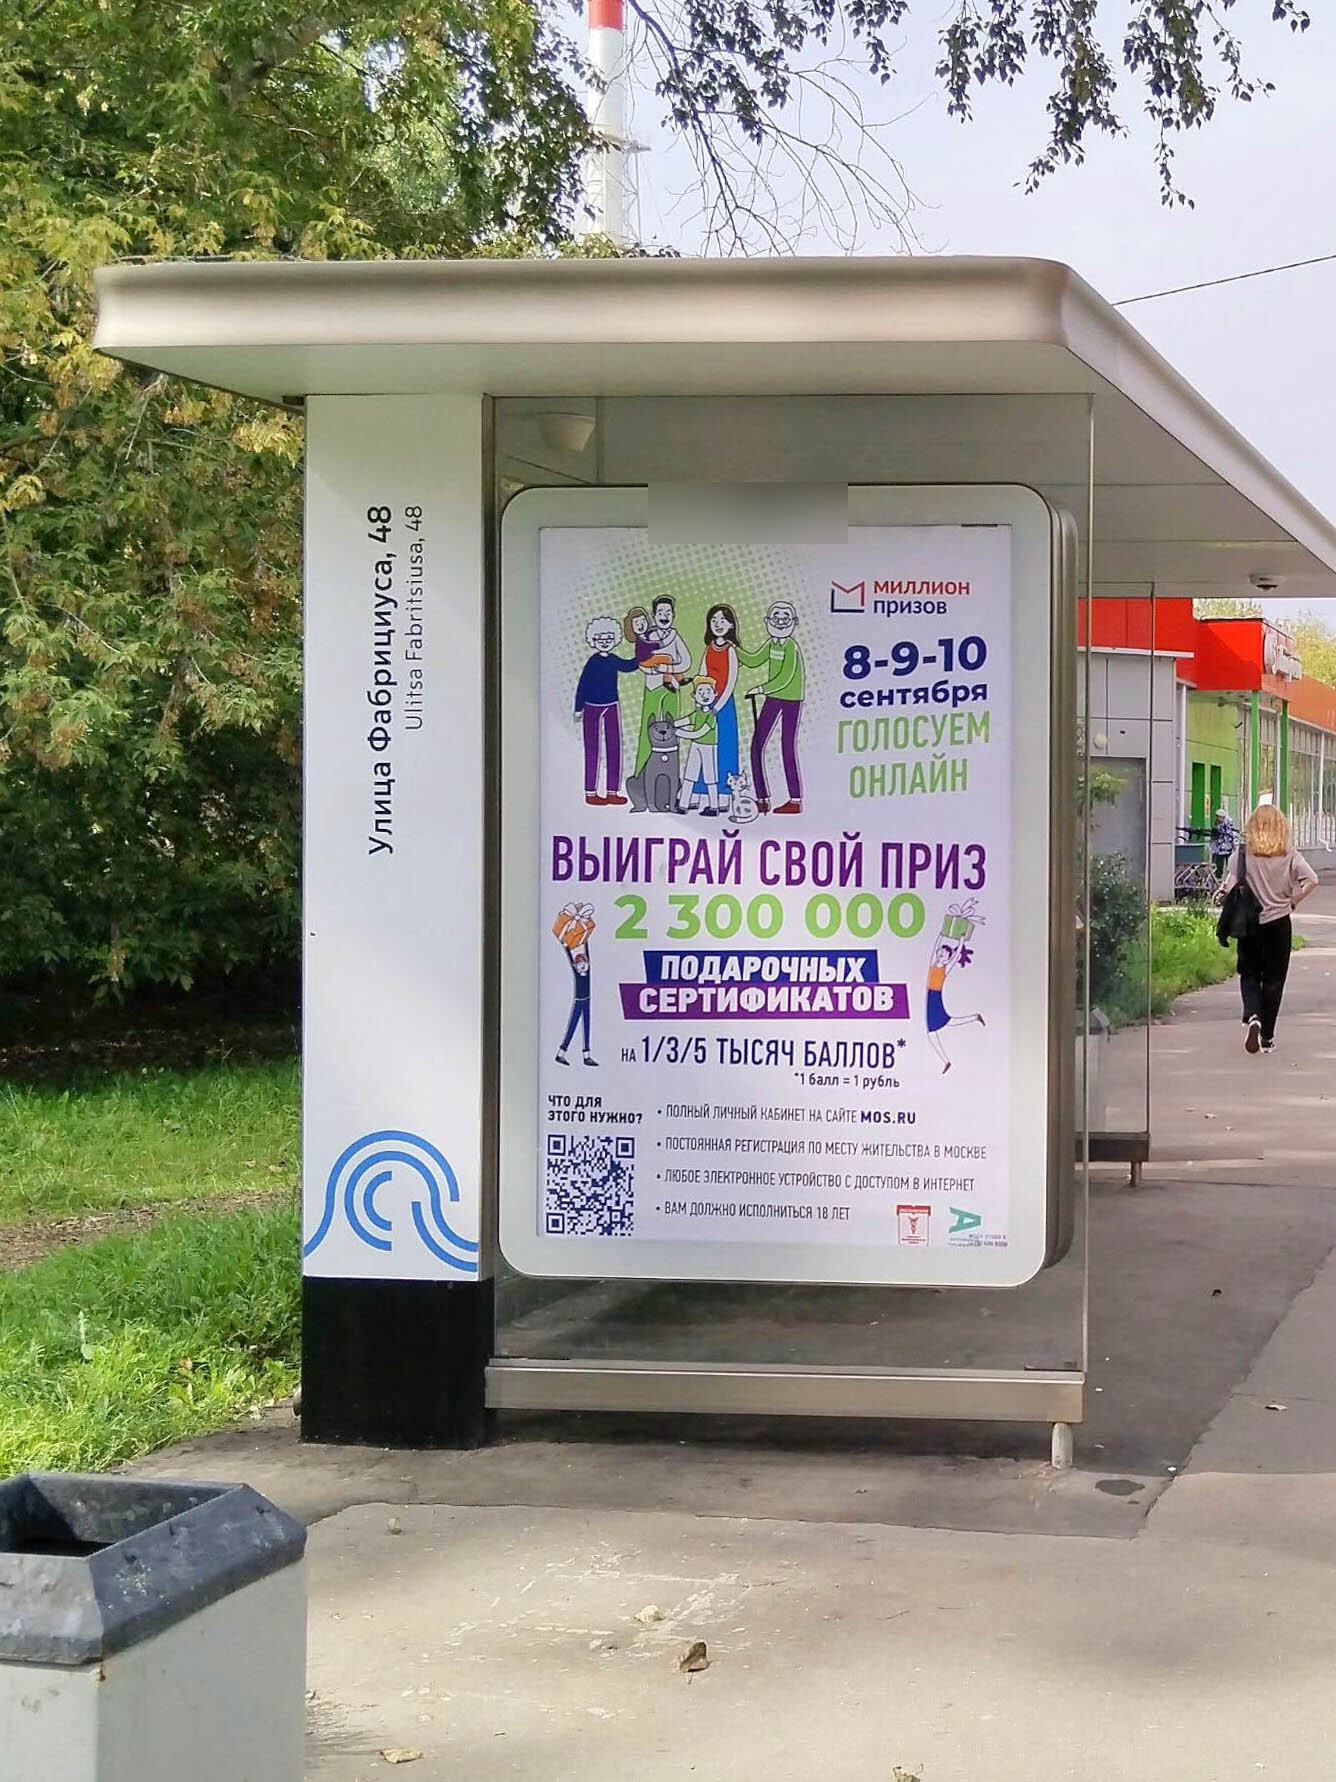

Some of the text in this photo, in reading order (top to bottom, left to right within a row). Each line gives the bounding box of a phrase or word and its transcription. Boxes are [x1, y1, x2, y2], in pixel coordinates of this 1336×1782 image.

[404, 505, 425, 730] Ulitsa Fabritsiusa, 48
[873, 598, 947, 617] призов
[843, 635, 987, 680] 8-9-10
[367, 505, 397, 855] Улица Фабрициуса, 48
[840, 680, 988, 709] сентября
[838, 711, 990, 754] ГОЛОСУЕМ
[849, 754, 968, 799] ОНЛАЙН
[552, 829, 987, 890] ВЫИГРАЙ СВОЙ ПРИЗ
[614, 892, 926, 940] 2 300 000
[661, 954, 866, 984] ПОДАРОЧНЫХ
[639, 985, 895, 1014] СЕРТИФИКАТОВ
[621, 1048, 637, 1063] НА
[641, 1036, 707, 1065] 1/3/5
[717, 1038, 794, 1067] ТЫСЯЧ
[808, 1074, 838, 1087] балл
[843, 1077, 851, 1085] =
[854, 1075, 860, 1087] 1
[863, 1075, 900, 1090] рубль
[548, 1095, 602, 1110] ЧТО ДЛЯ
[665, 1104, 916, 1125] ПОЛНЫЙ ЛИЧНЫЙ КАБИНЕТ НА САЙТЕ MOS.RU
[547, 1110, 644, 1125] ЭТОГО НУЖНО?
[665, 1136, 987, 1160] ПОСТОЯННАЯ РЕГИСТРАЦИЯ ПО МЕСТУ ЖИТЕЛЬСТВА В МОСКВЕ
[665, 1168, 974, 1191] ЛЮБОЕ ЭЛЕКТРОННОЕ УСТРОЙСТВО С ДОСТУПОМ В ИНТЕРНЕТ
[665, 1202, 850, 1221] ВАМ ДОЛЖНО ИСПОЛНИТЬСЯ 18 ЛЕТ
